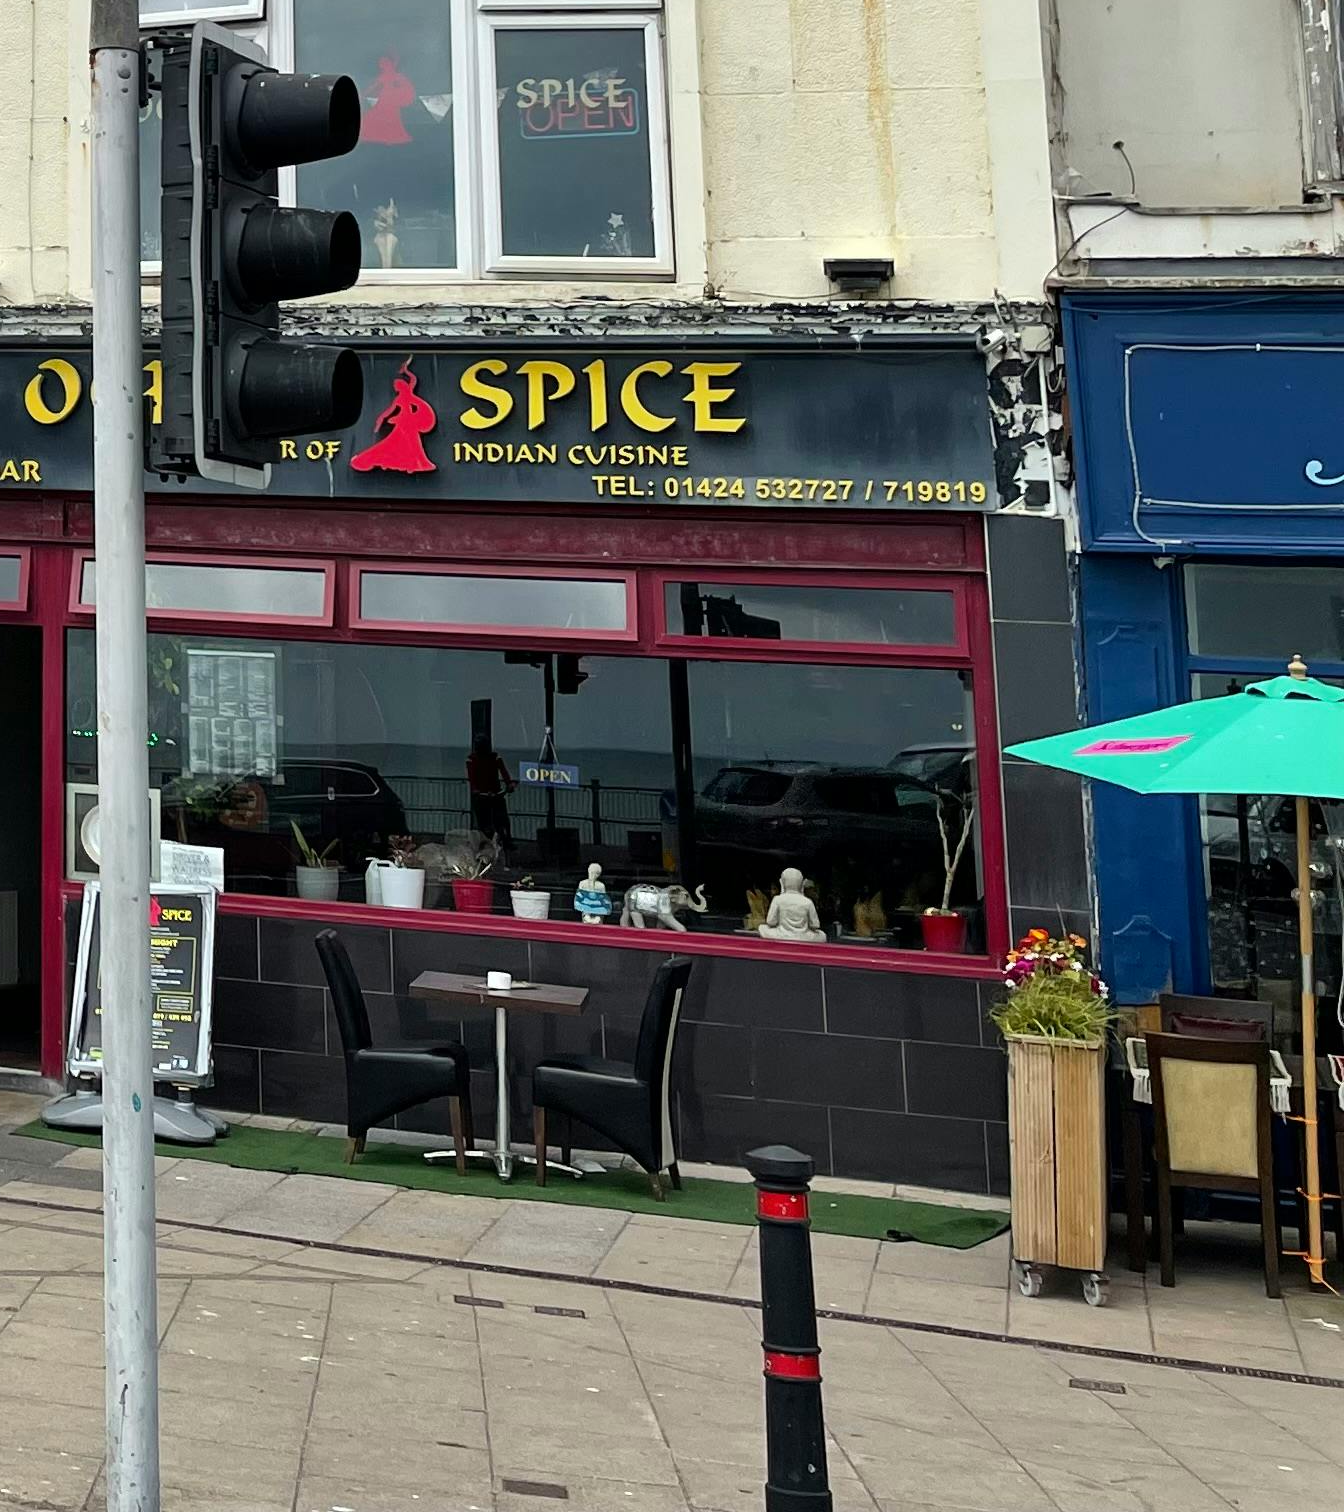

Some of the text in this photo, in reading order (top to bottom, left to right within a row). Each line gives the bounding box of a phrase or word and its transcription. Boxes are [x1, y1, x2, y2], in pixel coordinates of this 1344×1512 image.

[515, 78, 628, 109] SPICE
[523, 94, 634, 132] OPEN
[459, 358, 747, 433] SPICE
[306, 440, 342, 461] OF
[453, 442, 689, 467] INDIAN CUISINE
[592, 475, 986, 503] TEL: 01424 532727 / 719819
[526, 767, 572, 785] OPEN
[161, 909, 192, 922] SPICE
